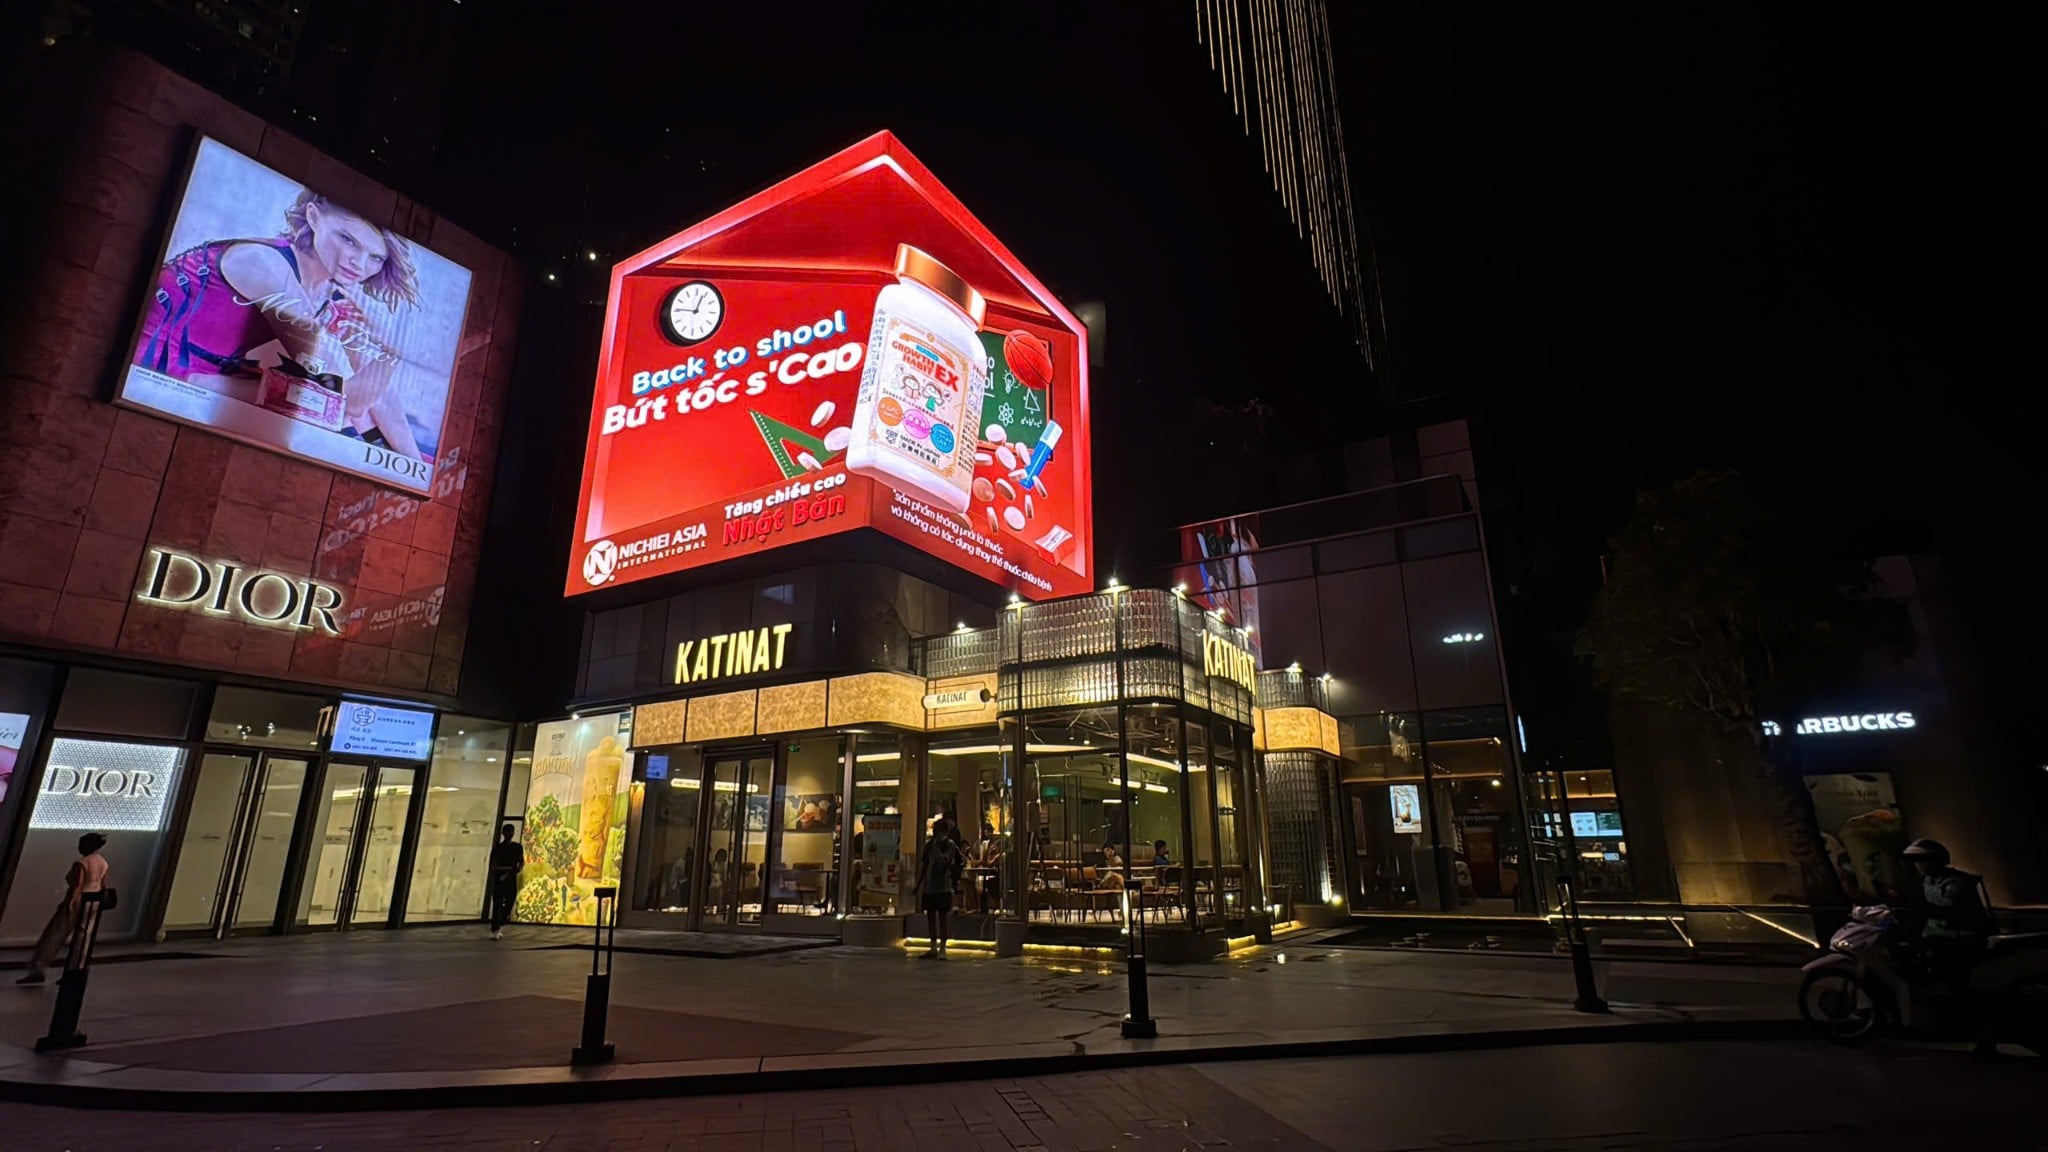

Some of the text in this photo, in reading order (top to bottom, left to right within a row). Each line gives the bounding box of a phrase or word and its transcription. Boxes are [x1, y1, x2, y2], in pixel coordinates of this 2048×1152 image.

[632, 356, 706, 395] Back
[714, 346, 750, 370] to
[756, 309, 847, 357] shool
[892, 340, 936, 368] GROWTH
[934, 363, 960, 392] EX
[902, 353, 934, 376] HABIT
[601, 394, 668, 435] Bứt
[675, 372, 740, 414] tốc
[364, 447, 427, 482] DIOR
[724, 499, 763, 519] Tăng
[814, 473, 847, 492] cao
[722, 492, 846, 546] Nhật Bản
[929, 525, 941, 537] có
[617, 540, 706, 570] INTERNATIONAL
[619, 523, 708, 560] NICHIEI ASIA
[137, 548, 342, 635] DIOR
[675, 623, 792, 684] KATINAT
[1202, 629, 1256, 696] KATINAT
[936, 691, 967, 704] KATINAT
[0, 728, 20, 740] ior
[41, 764, 157, 798] DIOR
